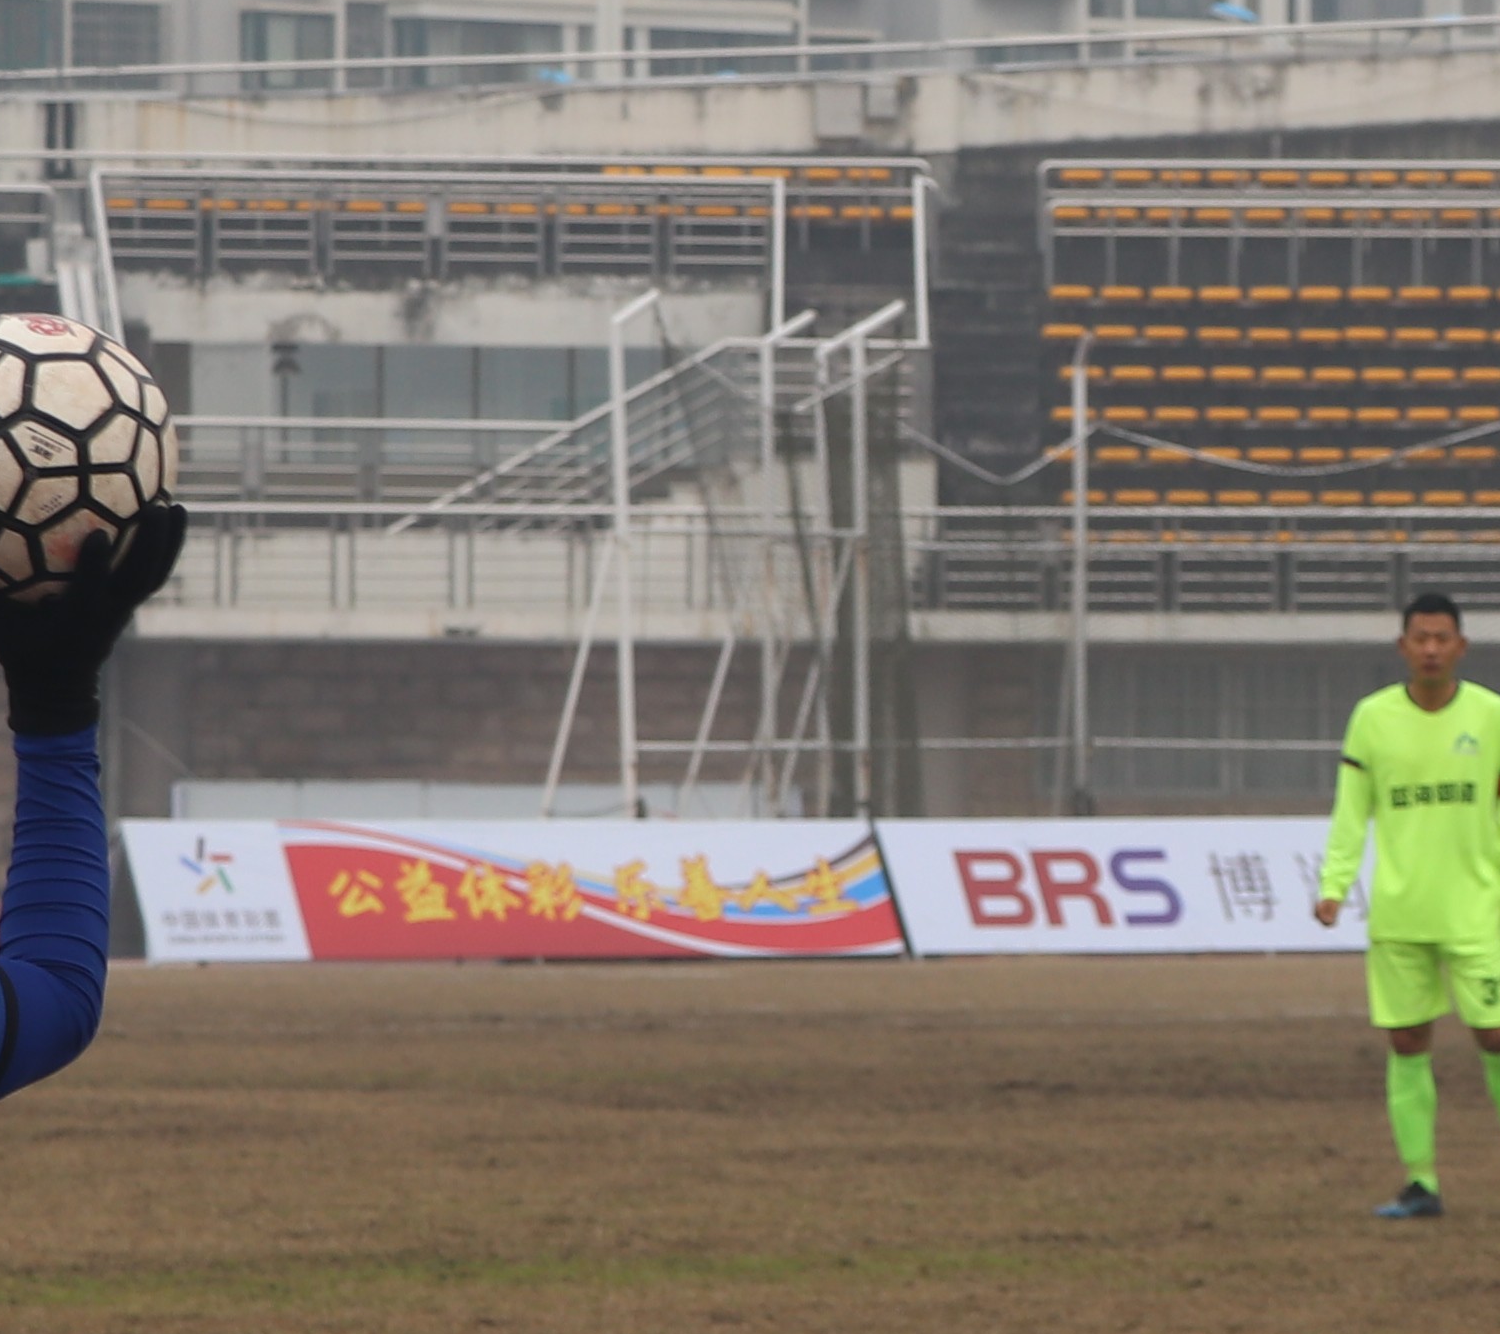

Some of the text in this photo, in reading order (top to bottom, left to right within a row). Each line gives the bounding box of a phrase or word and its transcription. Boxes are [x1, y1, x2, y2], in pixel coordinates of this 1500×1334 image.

[327, 857, 583, 923] 公益体彩
[954, 849, 1182, 928] BRS
